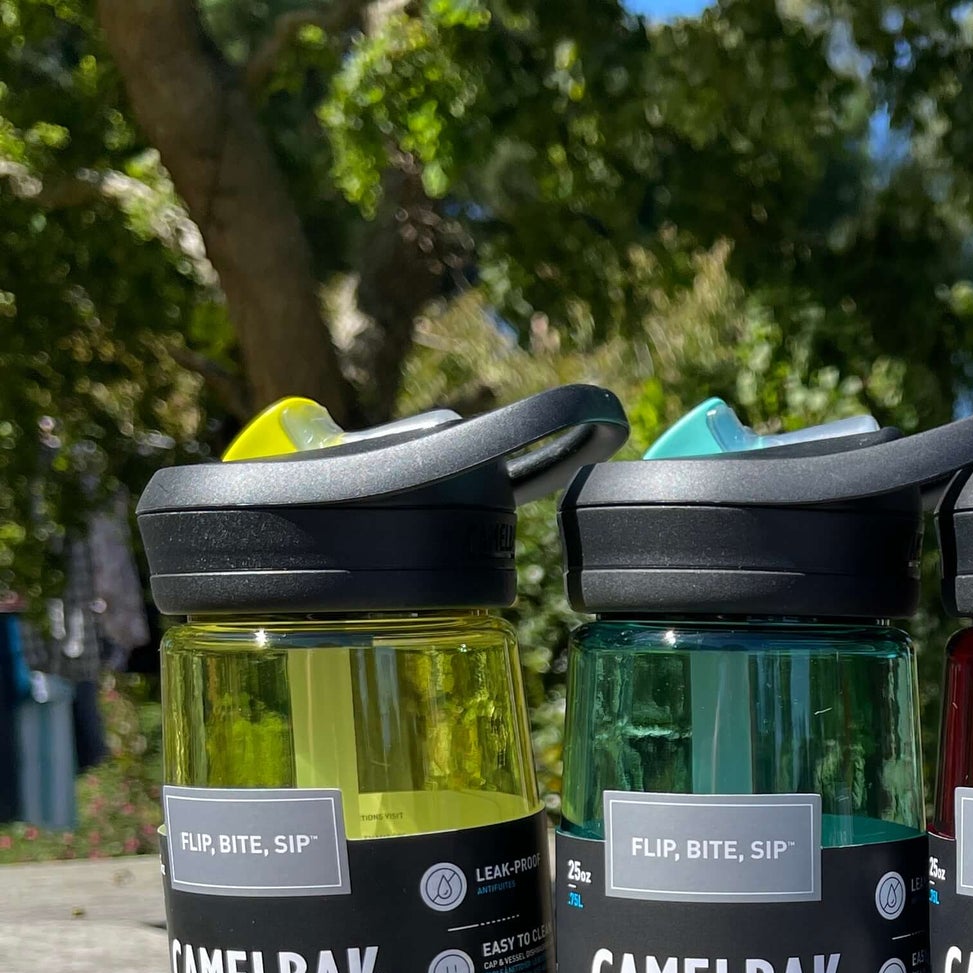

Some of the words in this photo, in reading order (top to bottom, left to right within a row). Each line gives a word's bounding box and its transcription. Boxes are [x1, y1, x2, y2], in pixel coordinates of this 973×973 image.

[181, 832, 216, 856] FLIP,
[219, 834, 269, 857] BITE,
[632, 837, 680, 861] FLIP,
[686, 840, 744, 863] BITE,
[568, 859, 592, 883] 25oz
[482, 936, 515, 957] EASY
[517, 932, 531, 948] TO
[484, 960, 498, 970] CAP
